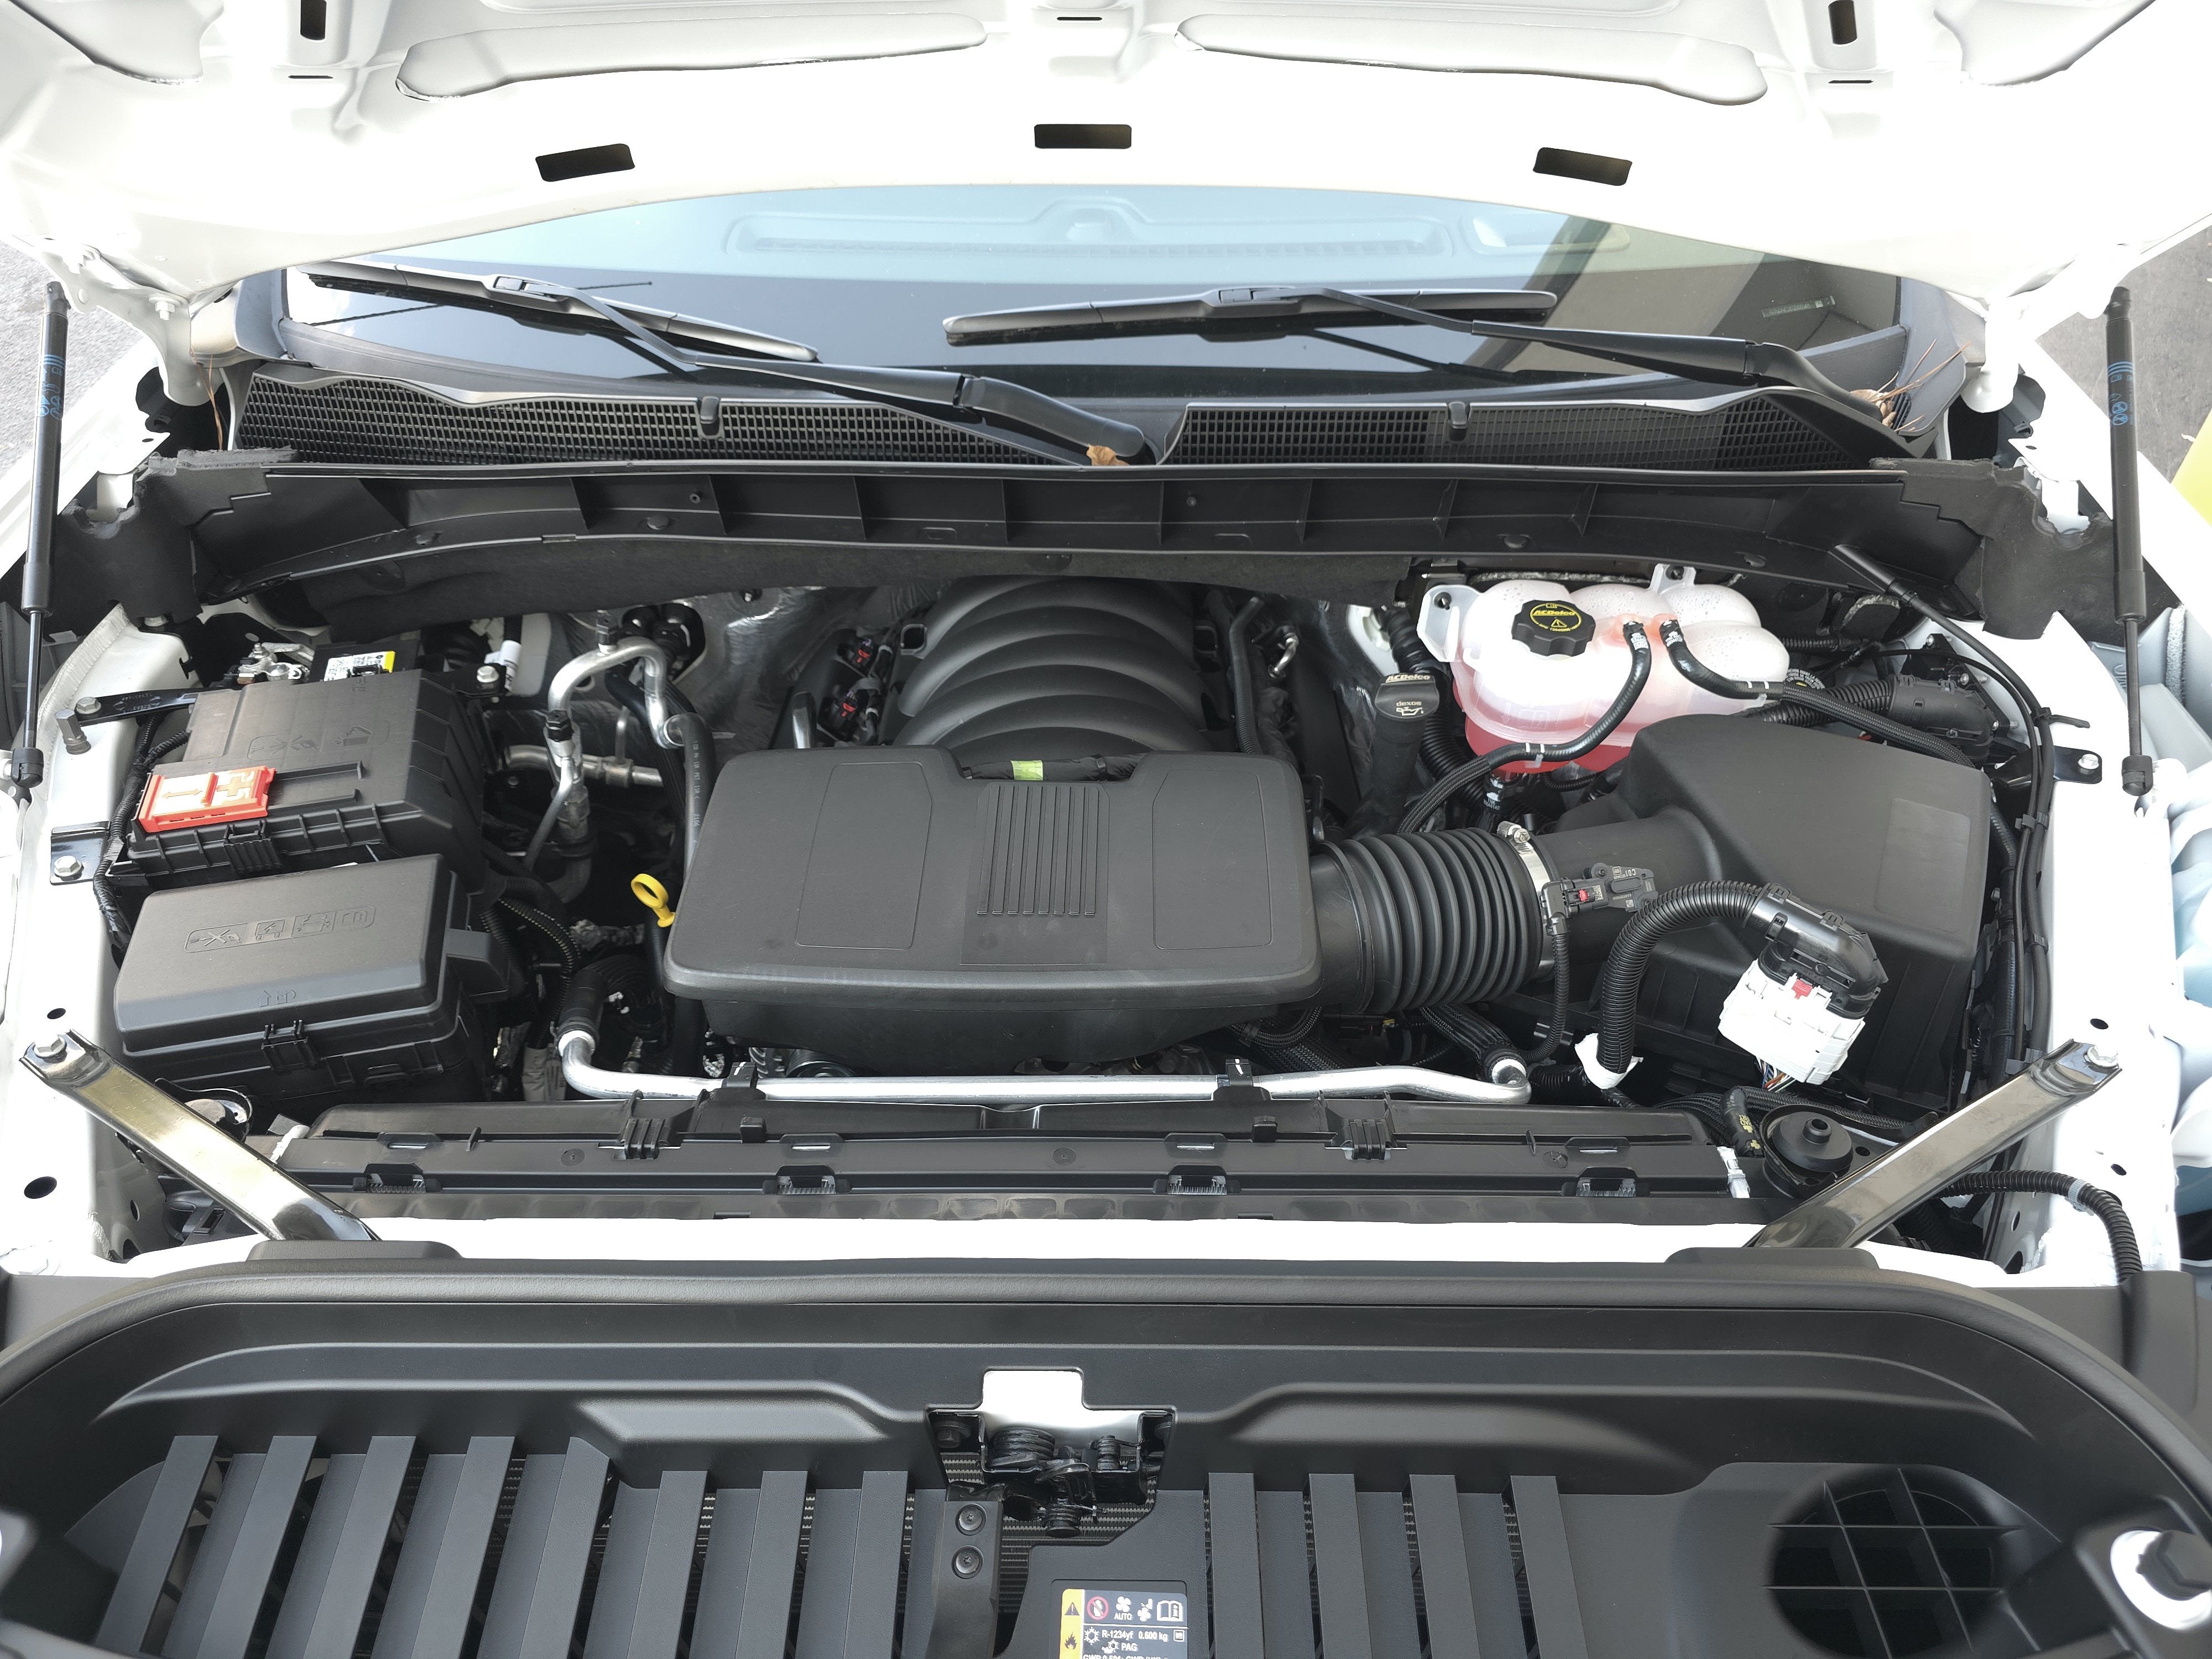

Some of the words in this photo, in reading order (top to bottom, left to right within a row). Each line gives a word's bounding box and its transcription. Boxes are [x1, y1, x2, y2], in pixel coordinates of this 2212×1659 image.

[1102, 1629, 1134, 1640] R-1234yf
[1138, 1631, 1158, 1640] 0.600
[1159, 1632, 1168, 1642] kg
[1121, 1643, 1138, 1651] PAG
